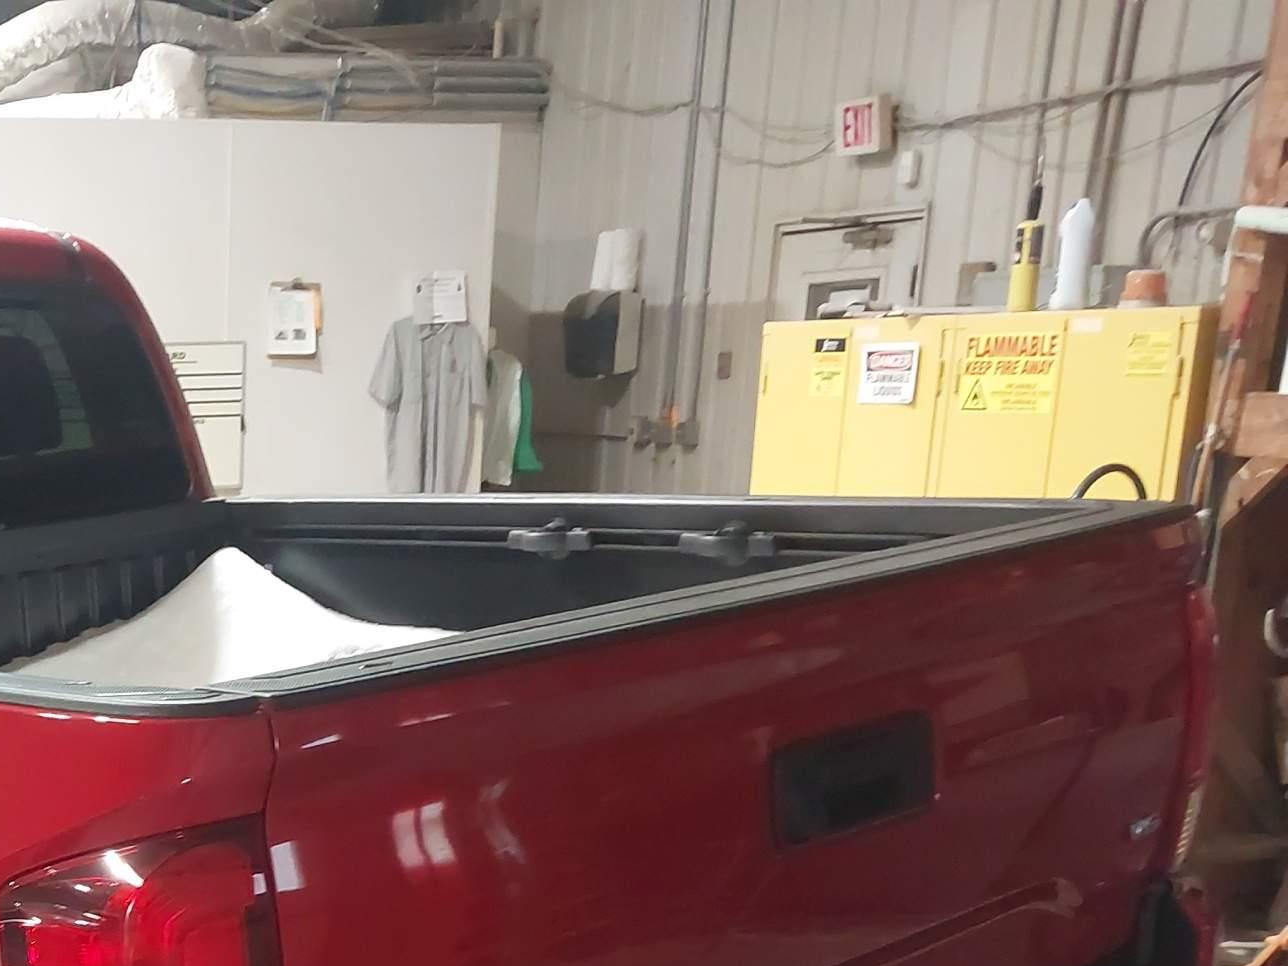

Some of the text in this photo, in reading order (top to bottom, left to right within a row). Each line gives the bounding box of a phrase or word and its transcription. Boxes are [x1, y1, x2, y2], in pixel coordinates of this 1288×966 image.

[843, 102, 873, 148] EXIT
[967, 334, 1057, 357] FLAMMABLE
[964, 359, 1055, 376] KEEP FIRE AWAY
